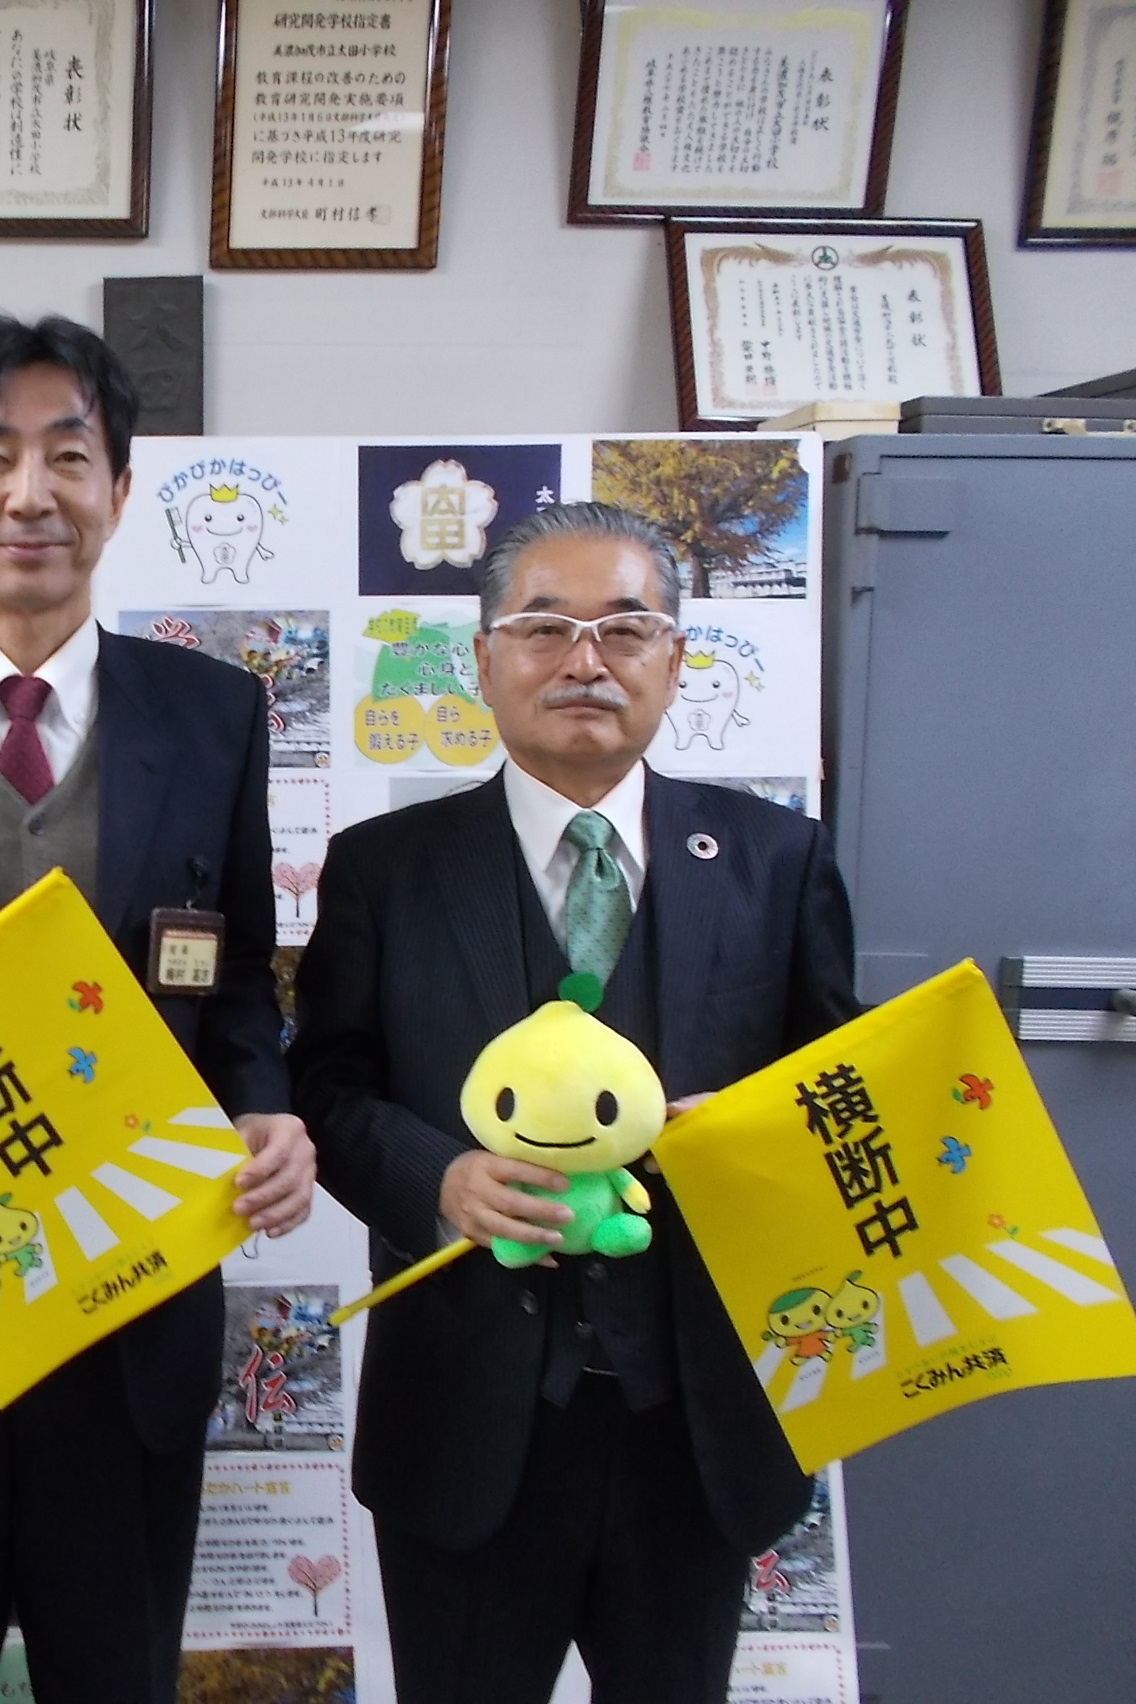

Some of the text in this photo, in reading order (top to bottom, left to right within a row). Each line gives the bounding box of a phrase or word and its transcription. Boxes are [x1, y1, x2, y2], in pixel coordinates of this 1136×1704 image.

[273, 12, 392, 30] 研究開発学校指定書
[272, 43, 397, 58] 美濃加茂市立太田小学校
[255, 71, 407, 86] 教育課程の改善のための
[254, 92, 405, 107] 教育研究開発実施要項
[812, 66, 834, 132] 表彰状
[253, 129, 402, 144] に基づき平成13年度研究
[251, 151, 383, 165] 開発学校に指定します
[794, 1063, 920, 1260] 横断中
[77, 1250, 168, 1315] こくみん共済
[900, 1347, 1007, 1398] こくみん共済
[239, 1343, 297, 1424] 伝
